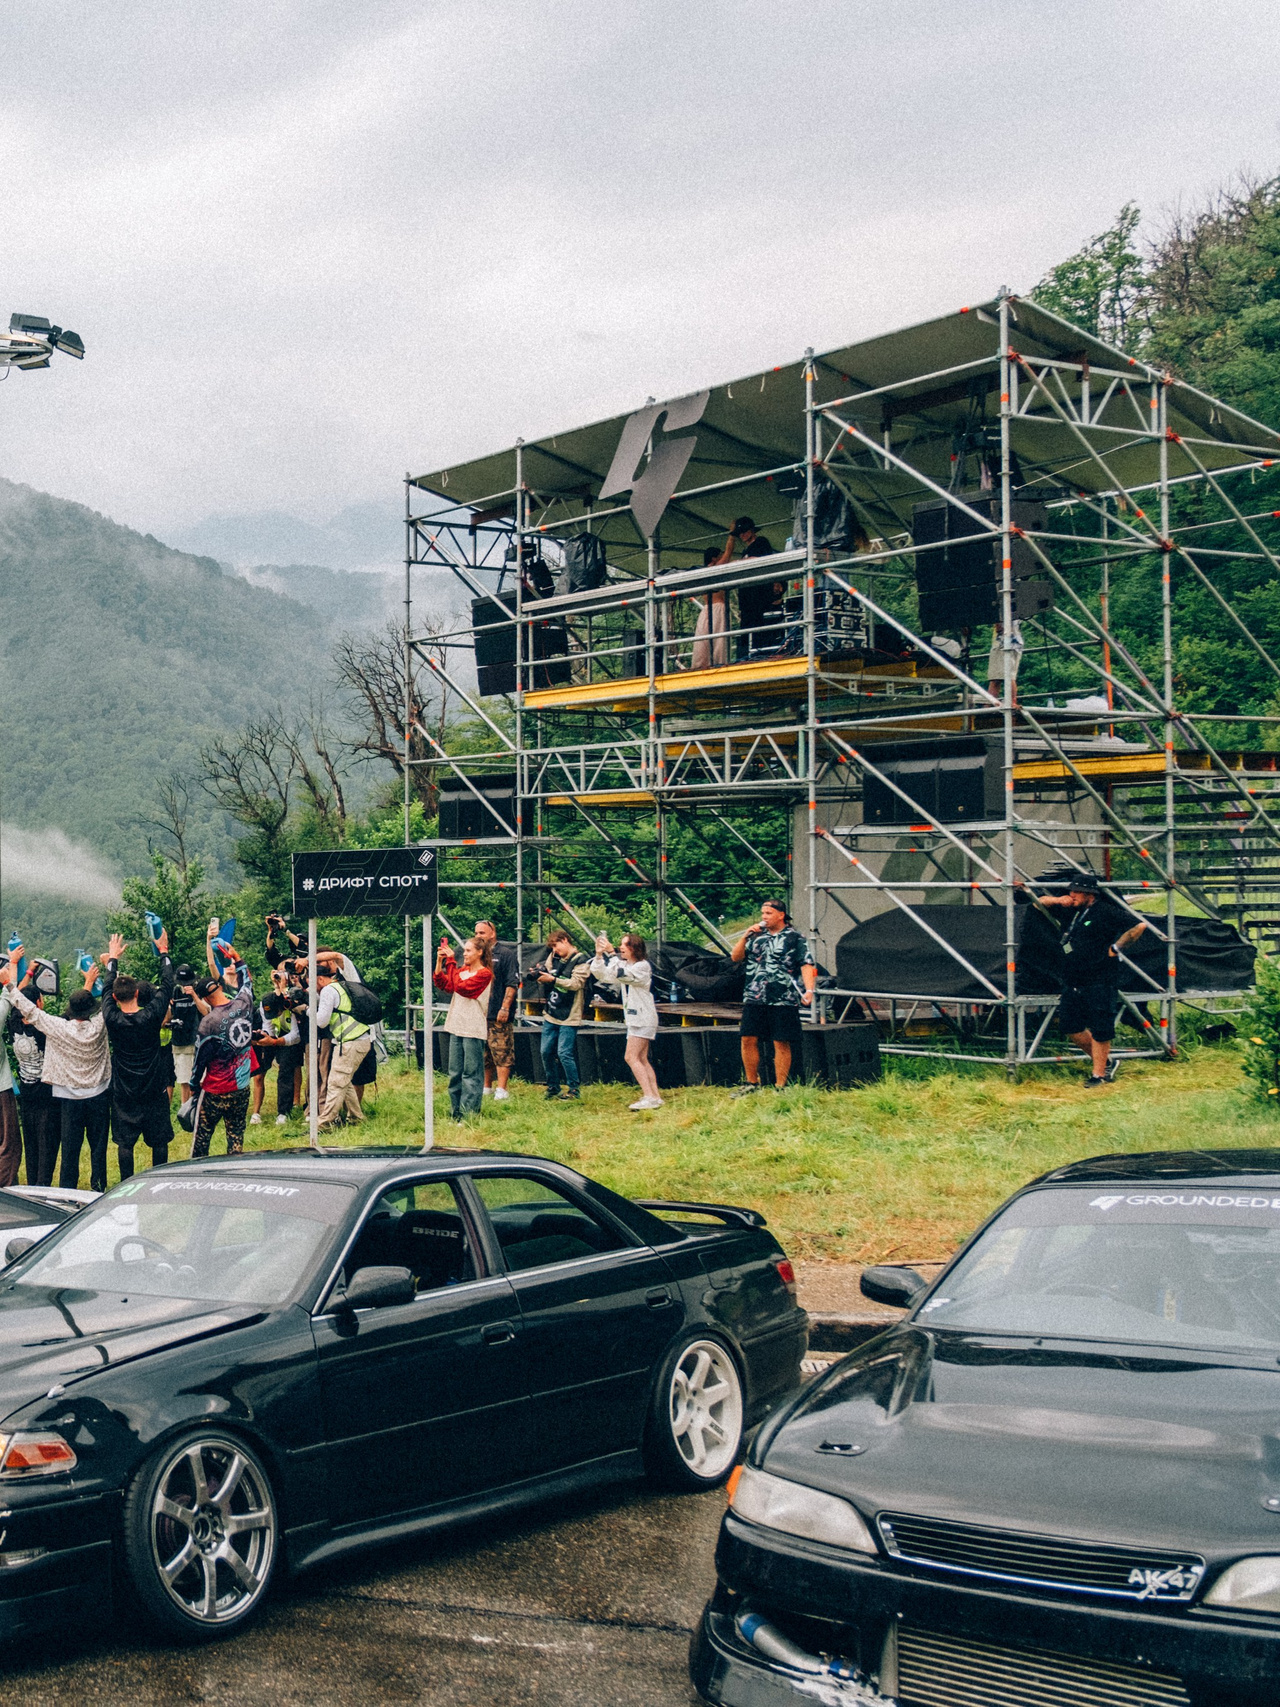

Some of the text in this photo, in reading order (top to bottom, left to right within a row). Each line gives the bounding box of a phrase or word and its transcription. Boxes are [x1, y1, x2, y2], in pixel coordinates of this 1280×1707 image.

[318, 876, 375, 891] ДРИФТ
[108, 1182, 147, 1200] 21
[412, 1226, 460, 1239] BRIDE
